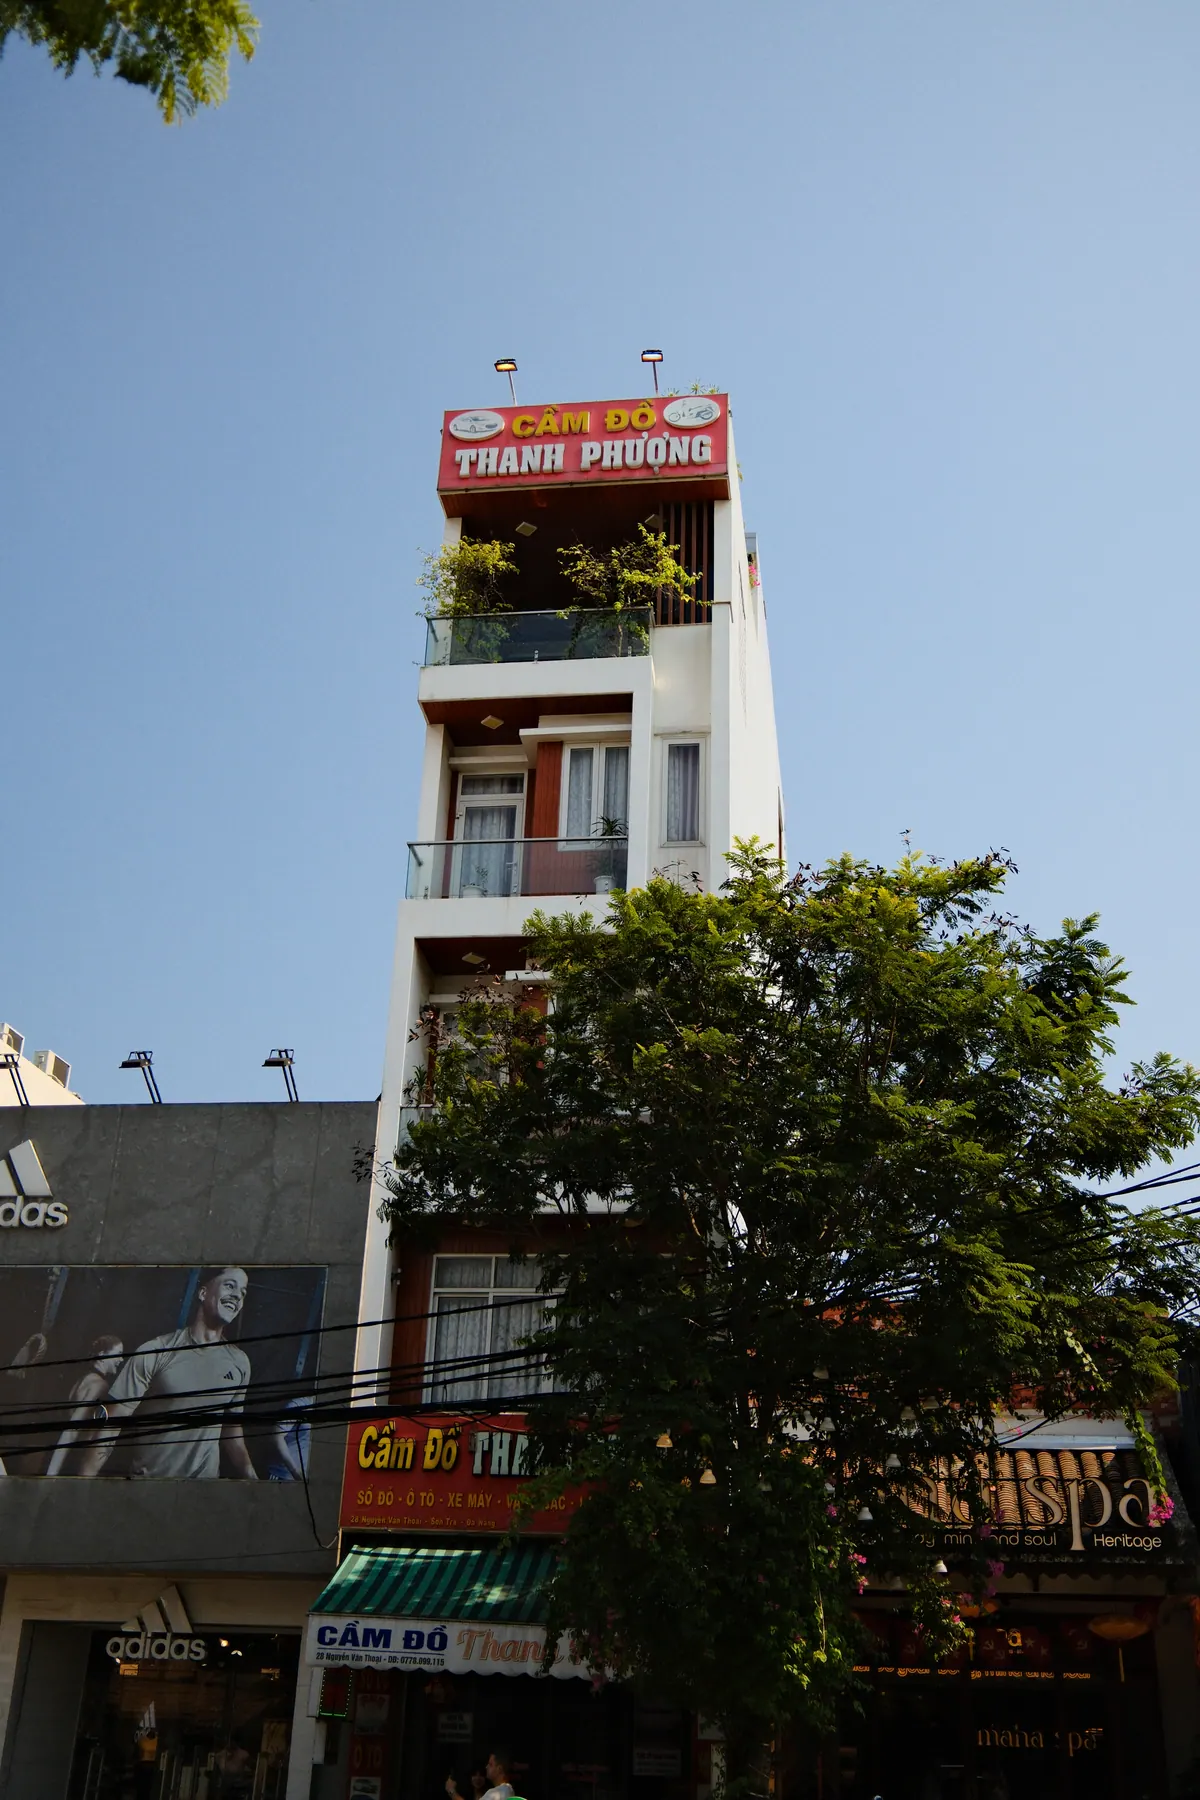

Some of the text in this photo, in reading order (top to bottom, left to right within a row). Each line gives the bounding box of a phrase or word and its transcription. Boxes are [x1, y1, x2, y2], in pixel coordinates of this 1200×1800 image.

[512, 399, 657, 438] CẦM ĐỒ
[455, 431, 713, 479] THANH PHƯỢNG
[358, 1420, 416, 1470] Cầm
[423, 1422, 462, 1471] Đồ
[448, 1492, 464, 1508] XE
[468, 1488, 493, 1508] MÁY
[350, 1516, 358, 1524] 28
[1024, 1532, 1057, 1546] soul
[1094, 1533, 1162, 1551] Heritage
[105, 1631, 208, 1661] adidas
[317, 1620, 392, 1648] CẦM
[403, 1624, 448, 1651] ĐỒ
[315, 1651, 325, 1661] 28
[400, 1657, 445, 1667] 0778.099.115
